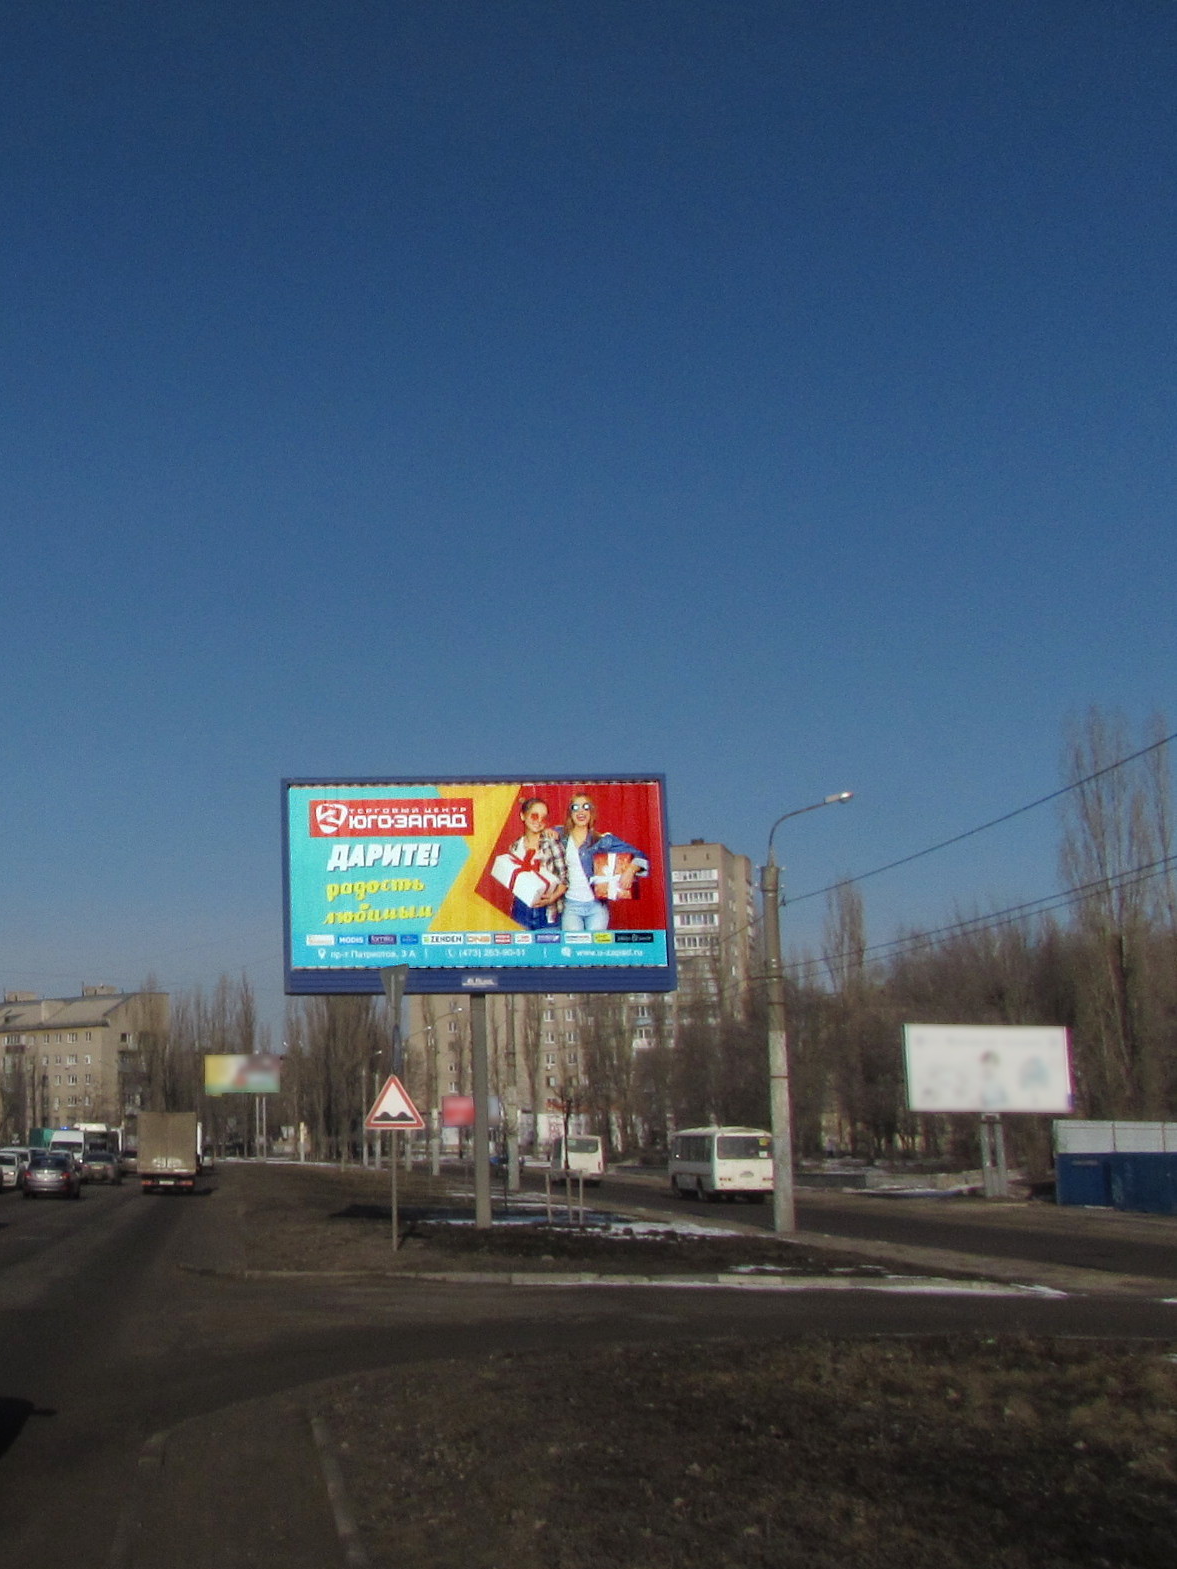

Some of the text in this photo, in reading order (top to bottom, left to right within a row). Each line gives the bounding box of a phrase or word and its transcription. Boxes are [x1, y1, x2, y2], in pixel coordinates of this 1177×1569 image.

[326, 843, 441, 872] ДАРИТЕ!
[326, 878, 426, 902] радость
[323, 903, 433, 924] любимым
[431, 935, 462, 943] ZENDEN
